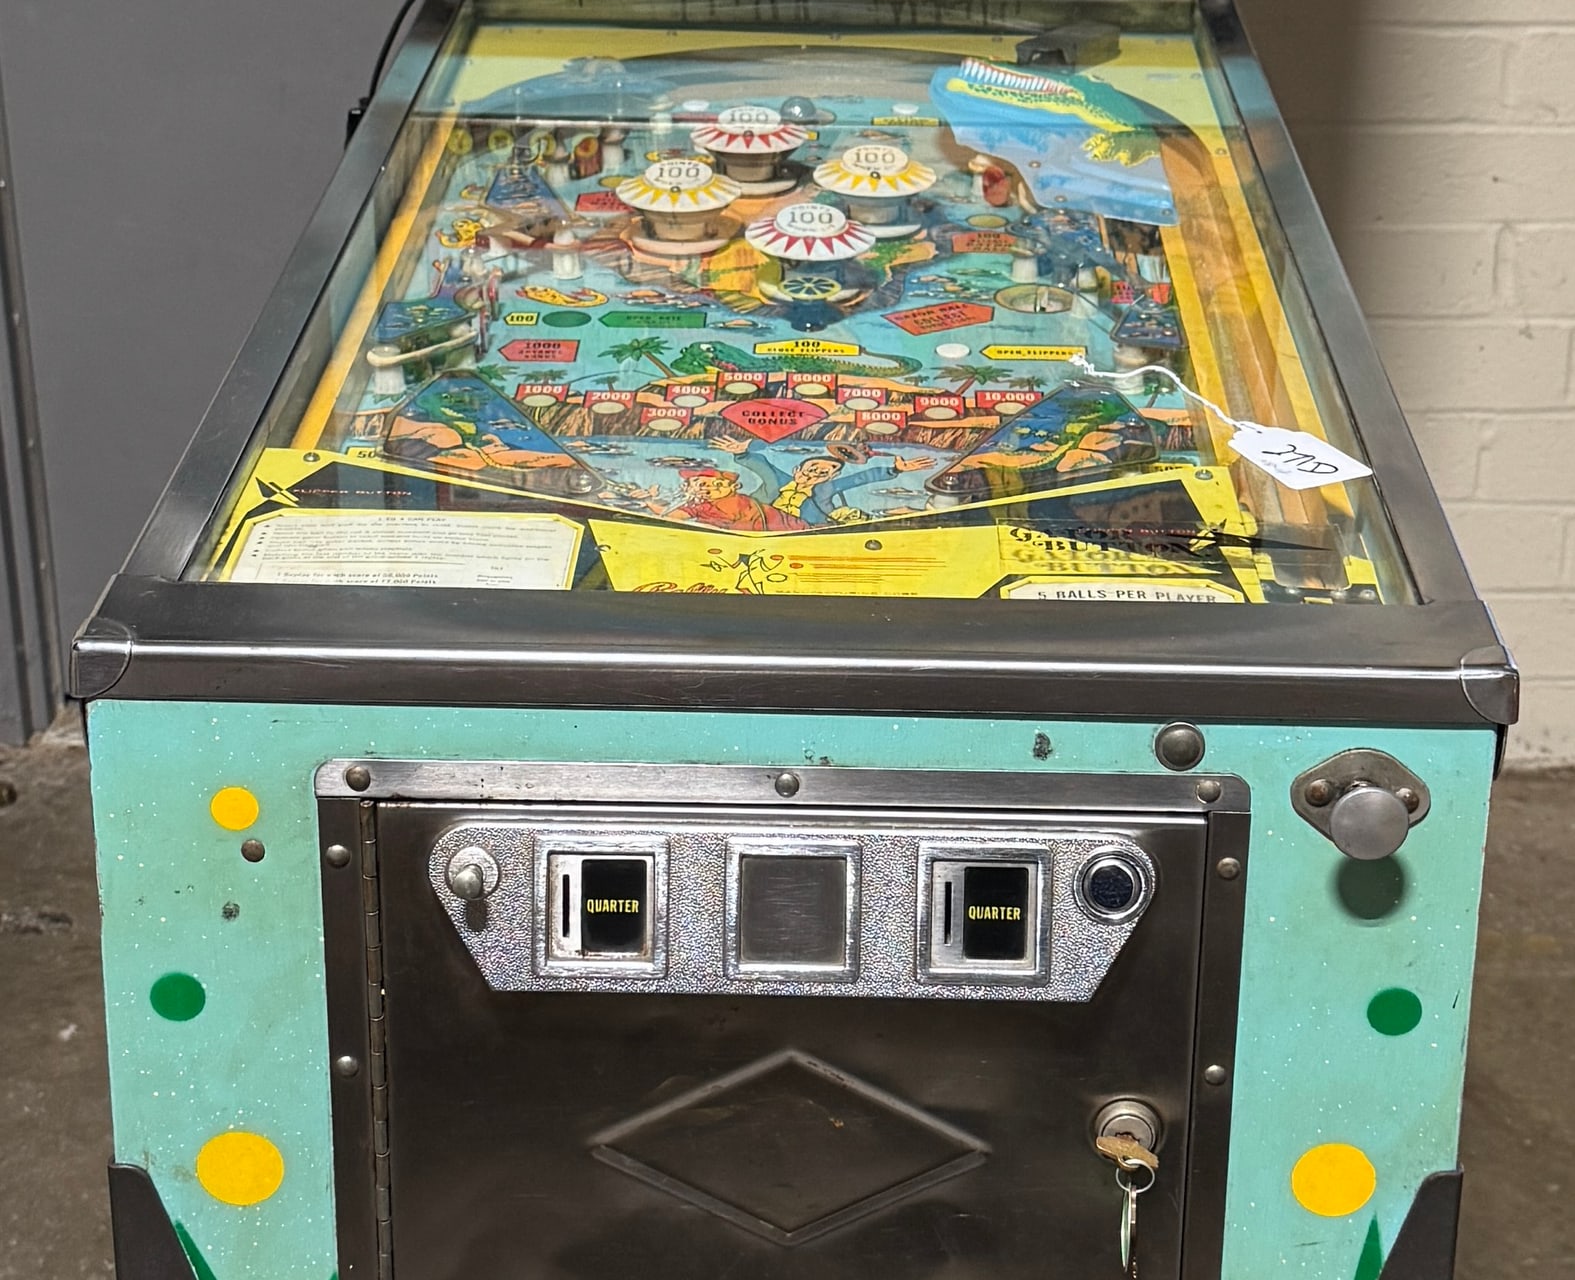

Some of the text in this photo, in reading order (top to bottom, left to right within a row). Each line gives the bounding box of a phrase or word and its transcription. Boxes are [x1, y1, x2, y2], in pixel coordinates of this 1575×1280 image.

[855, 151, 895, 164] 100
[659, 167, 700, 178] 100
[790, 211, 833, 224] 100
[723, 372, 763, 381] 5000
[792, 374, 832, 382] 6000
[524, 385, 562, 394] 1000
[671, 385, 710, 395] 4000
[842, 389, 881, 398] 7000
[592, 392, 631, 401] 2000
[920, 397, 959, 407] 9000
[647, 408, 687, 418] 3000
[861, 412, 901, 421] 8000
[1038, 591, 1046, 600] 5
[1057, 589, 1107, 599] BALLS
[1117, 590, 1147, 599] PER
[587, 899, 639, 913] QUARTER
[968, 906, 1021, 920] QUARTER
